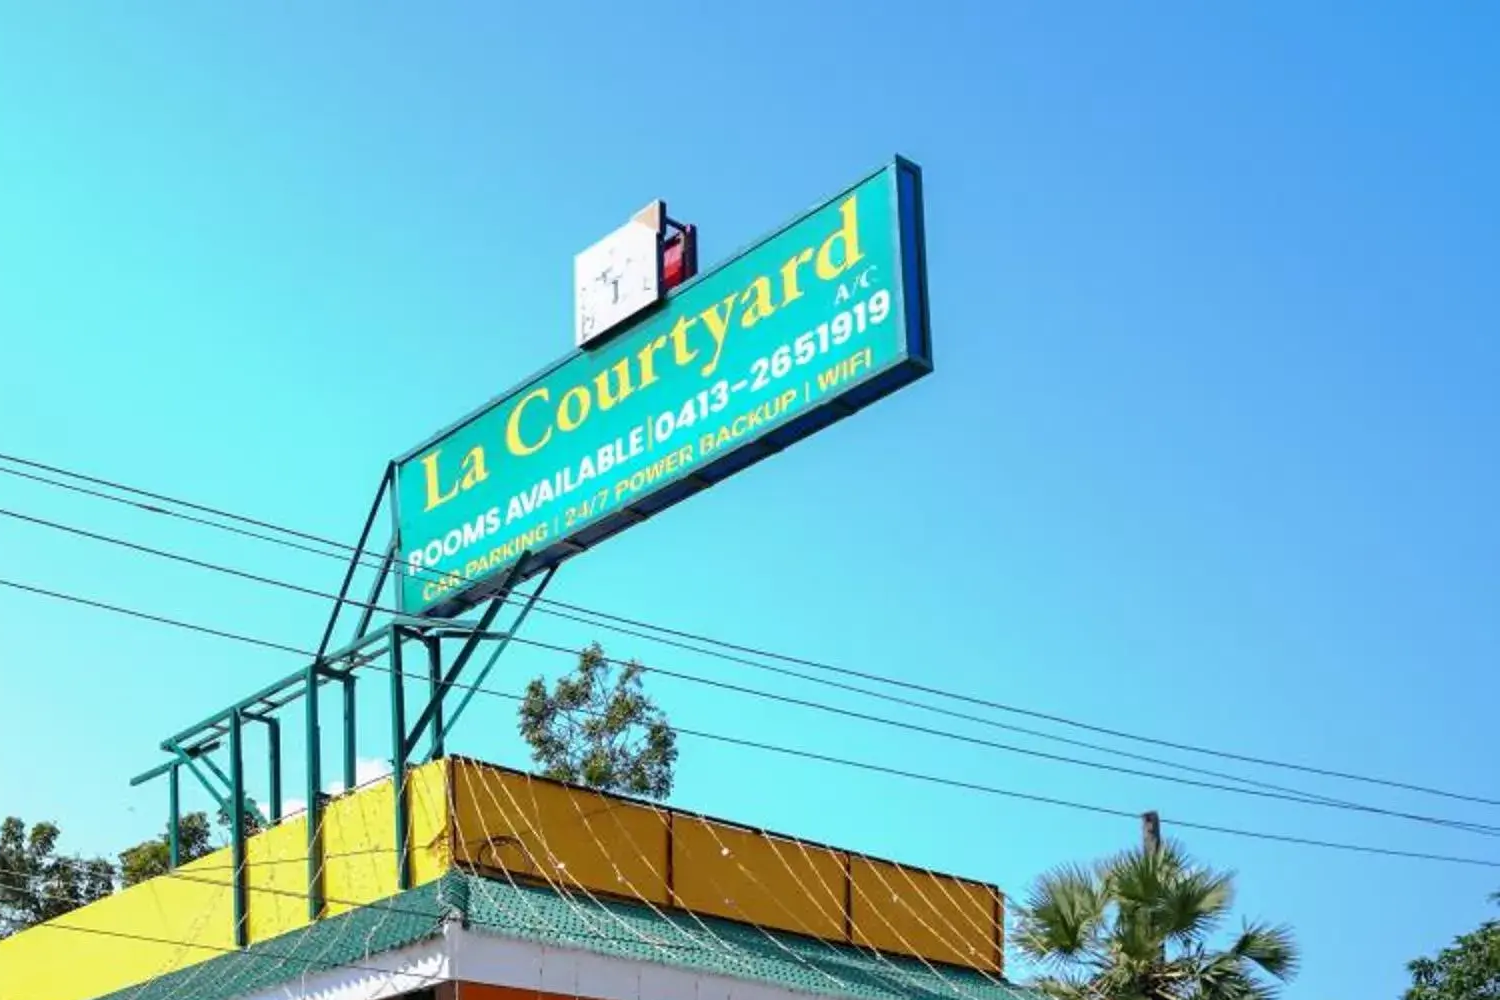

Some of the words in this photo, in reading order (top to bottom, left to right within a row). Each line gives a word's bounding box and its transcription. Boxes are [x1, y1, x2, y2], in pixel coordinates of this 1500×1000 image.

[420, 444, 490, 512] La
[505, 195, 865, 456] Courtyard
[834, 265, 880, 306] A/C
[407, 507, 501, 576] ROOMS
[505, 426, 644, 525] AVAILABLE
[654, 289, 891, 443] 0413-2651919
[423, 570, 465, 601] CAR
[465, 522, 548, 579] PARKING
[565, 489, 608, 527] 24/7
[614, 445, 694, 502] POWER
[700, 389, 798, 457] BACKUP
[817, 348, 873, 393] WIFI
